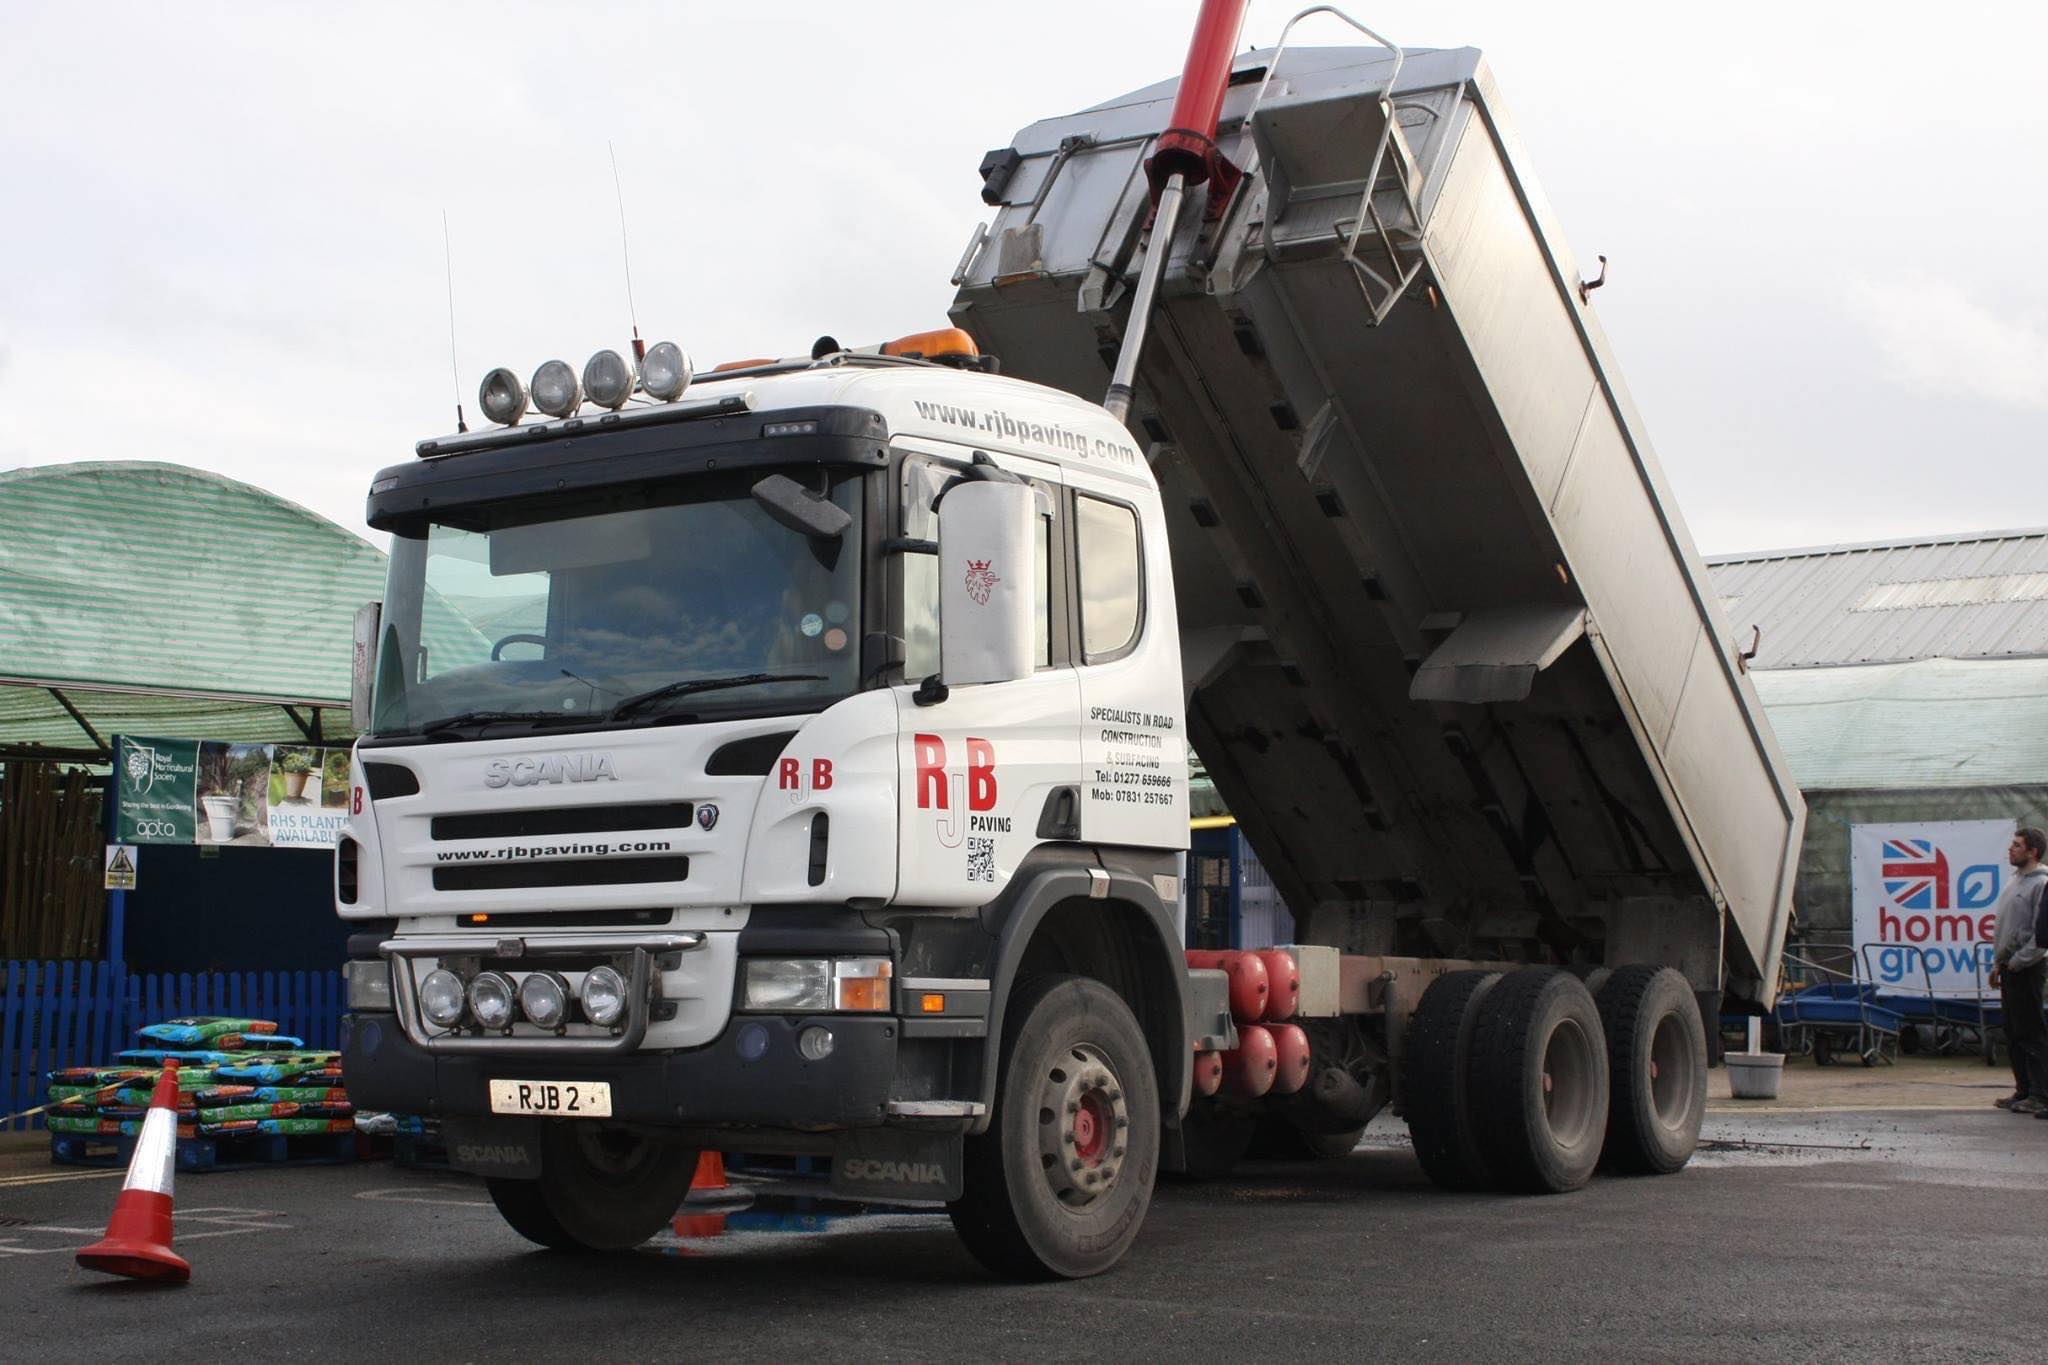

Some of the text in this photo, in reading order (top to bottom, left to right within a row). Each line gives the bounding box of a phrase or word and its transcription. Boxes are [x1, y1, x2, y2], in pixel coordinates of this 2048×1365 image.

[914, 400, 1136, 465] www.rjbpaving.com
[1090, 706, 1174, 729] SPECIALISTS IN ROAD
[1101, 729, 1162, 749] CONSTRUCTION
[154, 763, 194, 774] Horticultural
[155, 753, 173, 764] Royal
[1105, 750, 1160, 769] & SURFACING
[153, 772, 177, 783] Society
[484, 752, 621, 789] SCANIA
[1095, 769, 1172, 788] Tel: 01277 659666
[353, 786, 363, 815] B
[1091, 788, 1174, 806] Mob: 07831 257667
[136, 819, 176, 840] apta
[270, 814, 297, 828] RHS
[970, 815, 1011, 833] PAVING
[276, 828, 338, 844] AVAILABL
[436, 840, 671, 862] www.rjbpaving.com
[1879, 906, 1998, 943] home
[519, 1084, 580, 1111] RJB 2
[456, 1144, 531, 1165] SCANIA
[844, 1158, 947, 1184] SCANIA
